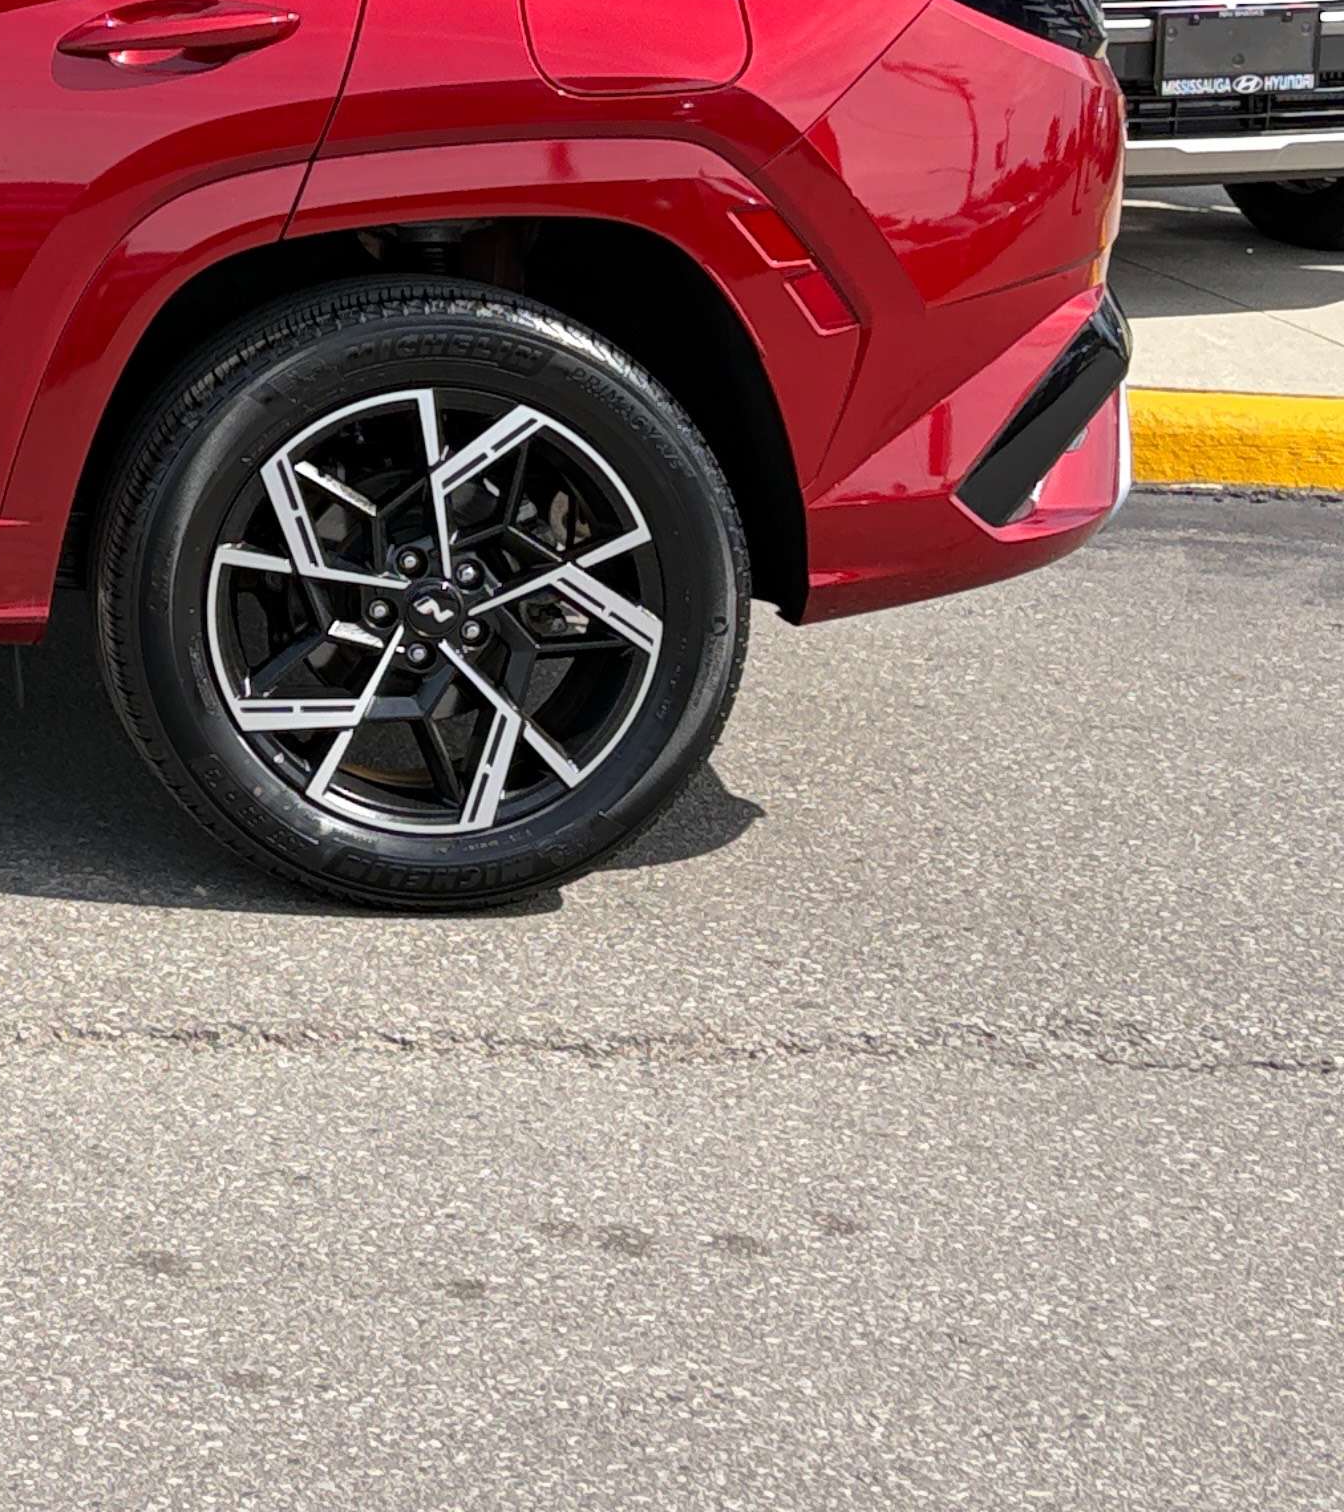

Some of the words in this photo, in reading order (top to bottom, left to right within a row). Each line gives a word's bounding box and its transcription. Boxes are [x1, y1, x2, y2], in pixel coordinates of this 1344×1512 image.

[1162, 77, 1232, 96] MISSISSAUGA
[1264, 74, 1315, 91] HYUNDAI
[345, 333, 543, 370] MICHELIN
